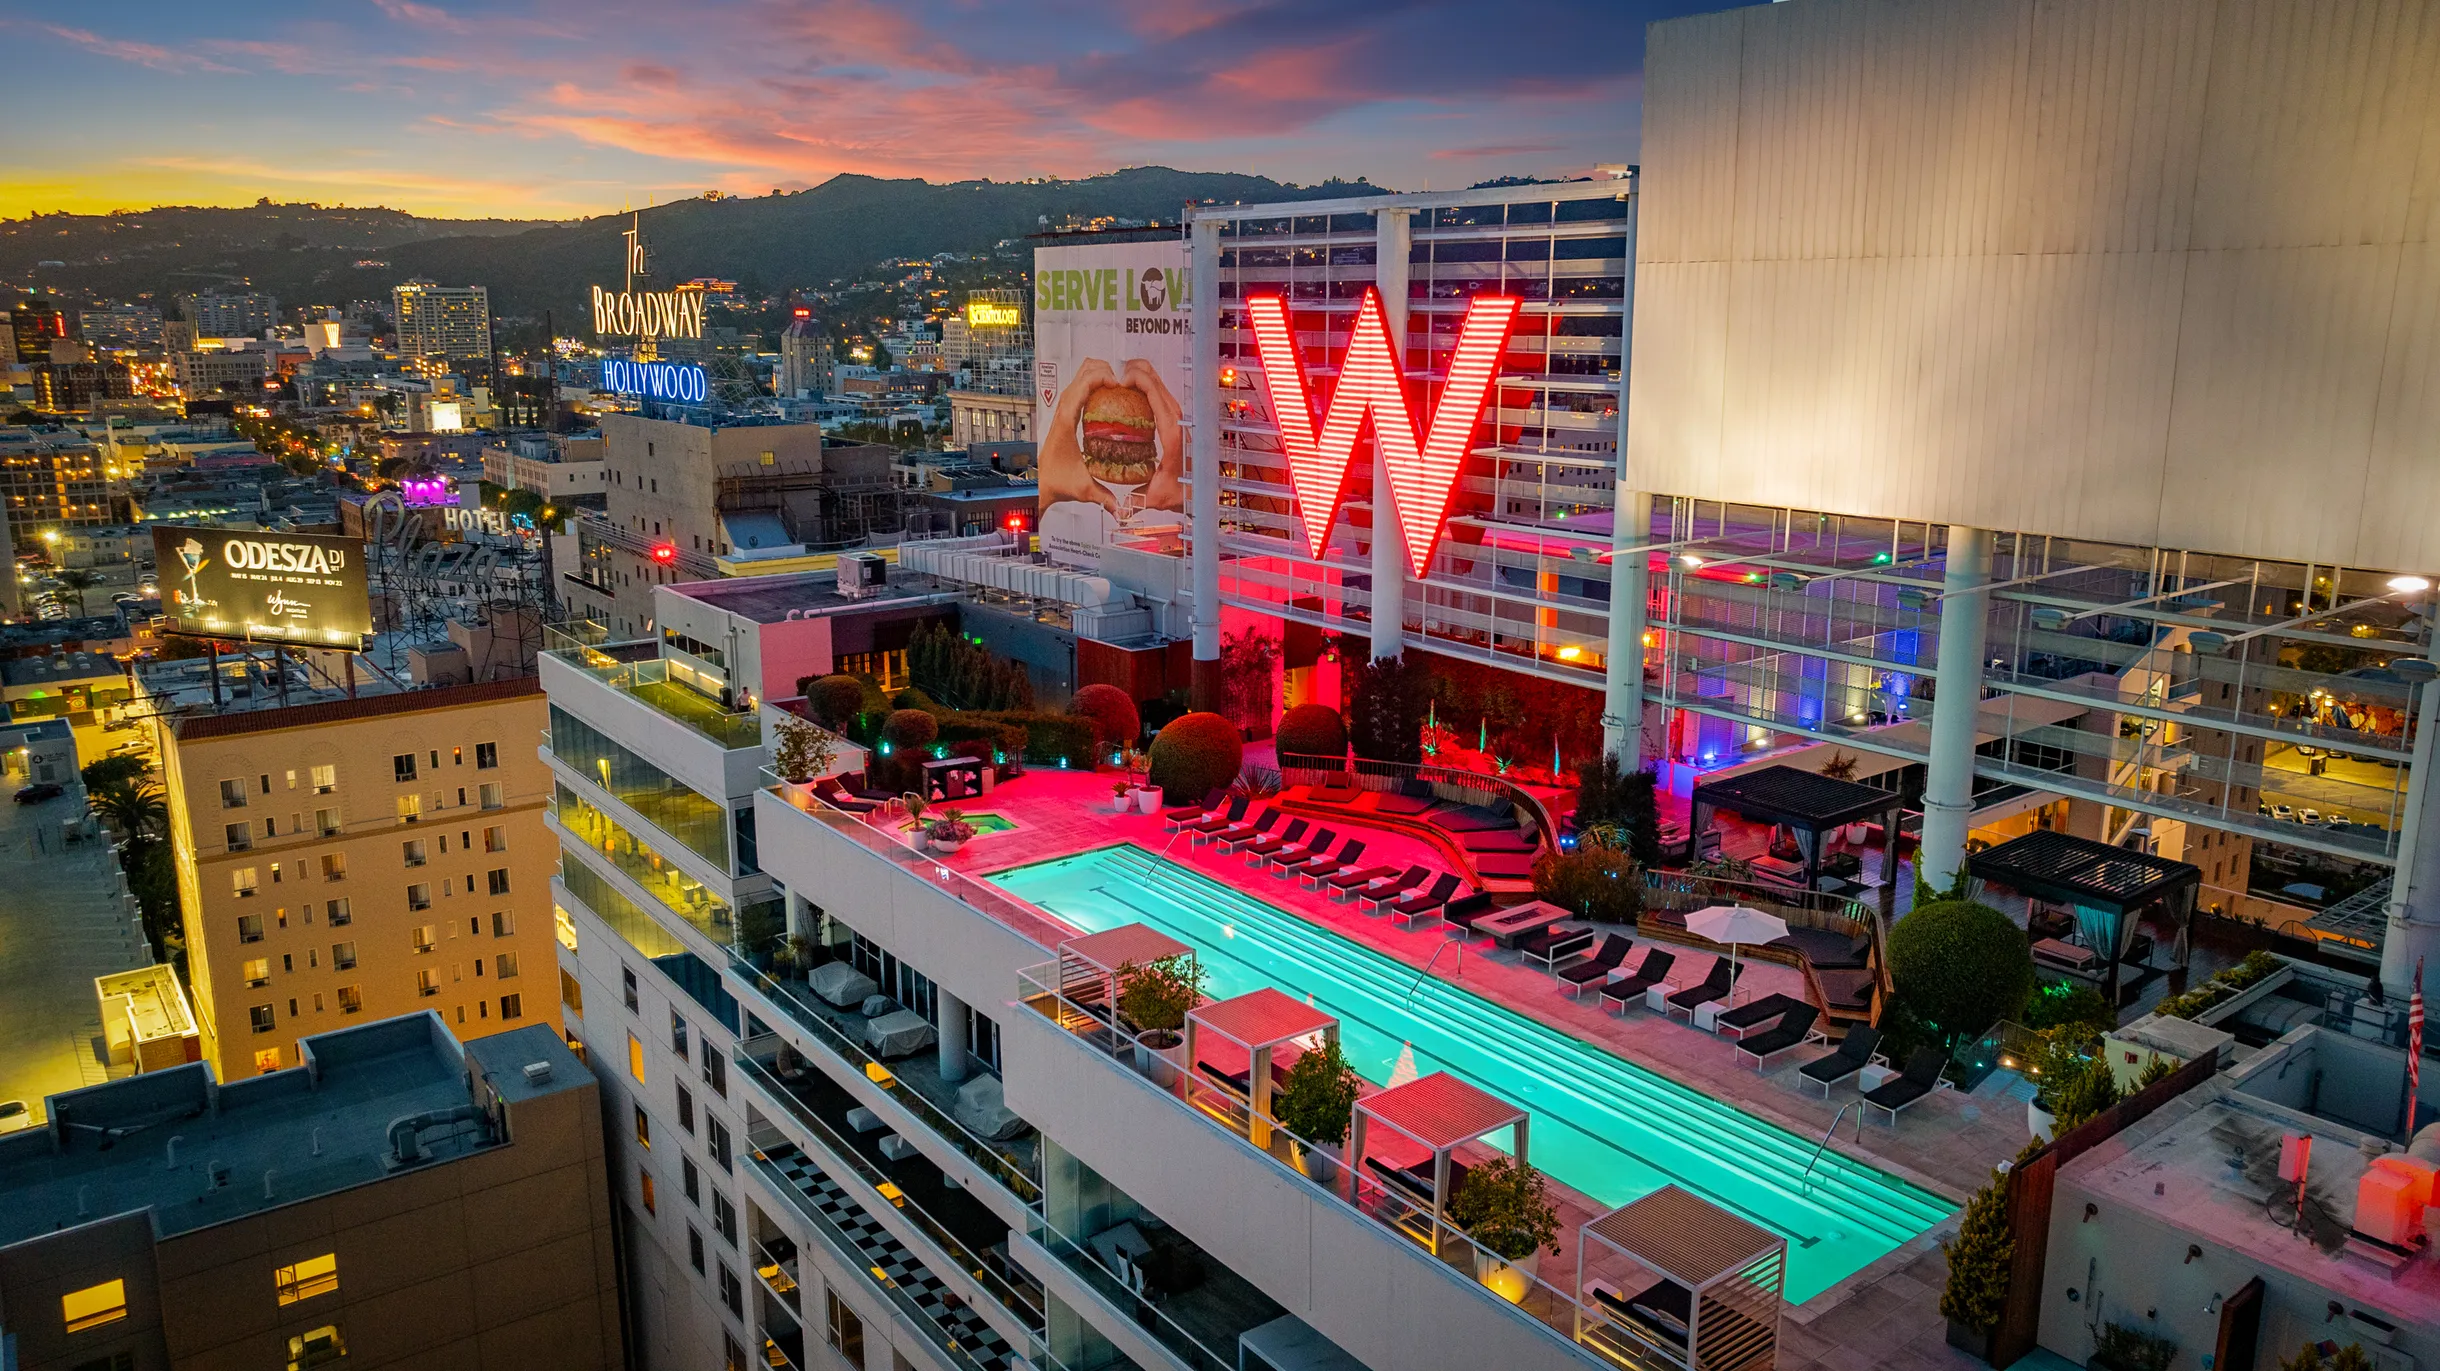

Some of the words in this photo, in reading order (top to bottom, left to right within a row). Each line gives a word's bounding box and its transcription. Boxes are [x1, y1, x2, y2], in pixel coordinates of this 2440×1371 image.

[1036, 268, 1118, 311] SERVE
[592, 285, 704, 339] BROADWAY
[969, 306, 1019, 325] SCIENTOLOGY
[1126, 317, 1170, 334] BEYOND
[604, 360, 706, 401] HOLLYWOOD
[1246, 286, 1524, 580] W
[363, 489, 501, 587] Plaza
[444, 507, 513, 536] HOTEL
[224, 539, 332, 575] ODESZA
[330, 550, 345, 568] DJ
